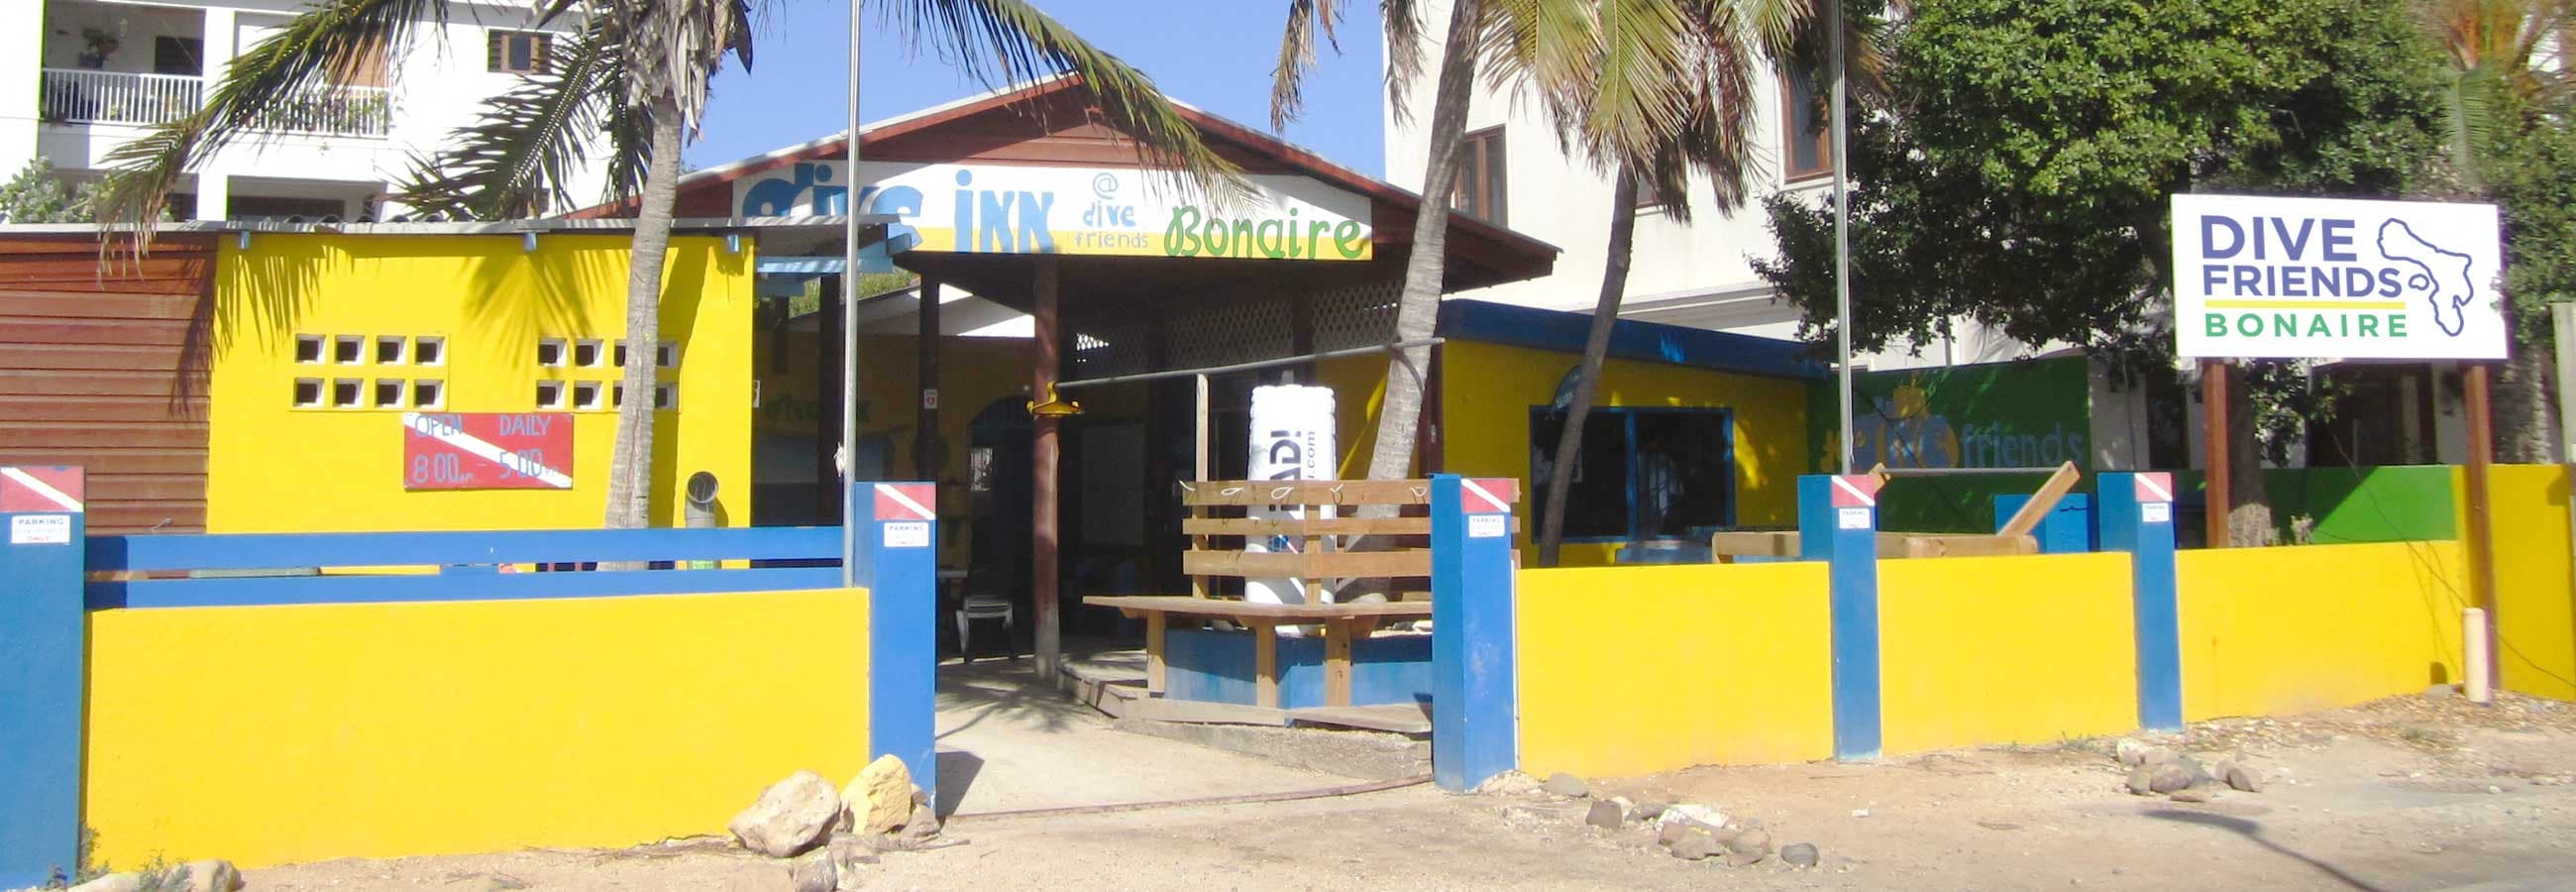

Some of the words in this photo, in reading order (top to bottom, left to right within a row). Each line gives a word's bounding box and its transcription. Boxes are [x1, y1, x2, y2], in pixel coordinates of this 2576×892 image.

[1093, 172, 1119, 199] @
[1082, 200, 1136, 227] dive
[1075, 231, 1148, 248] friends
[1164, 205, 1364, 260] Bonaire
[2200, 214, 2357, 262] DIVE
[2202, 265, 2403, 298] FRIENDS
[2205, 312, 2408, 338] BONAIRE
[414, 415, 463, 437] OPEN
[498, 414, 551, 436] DAILY
